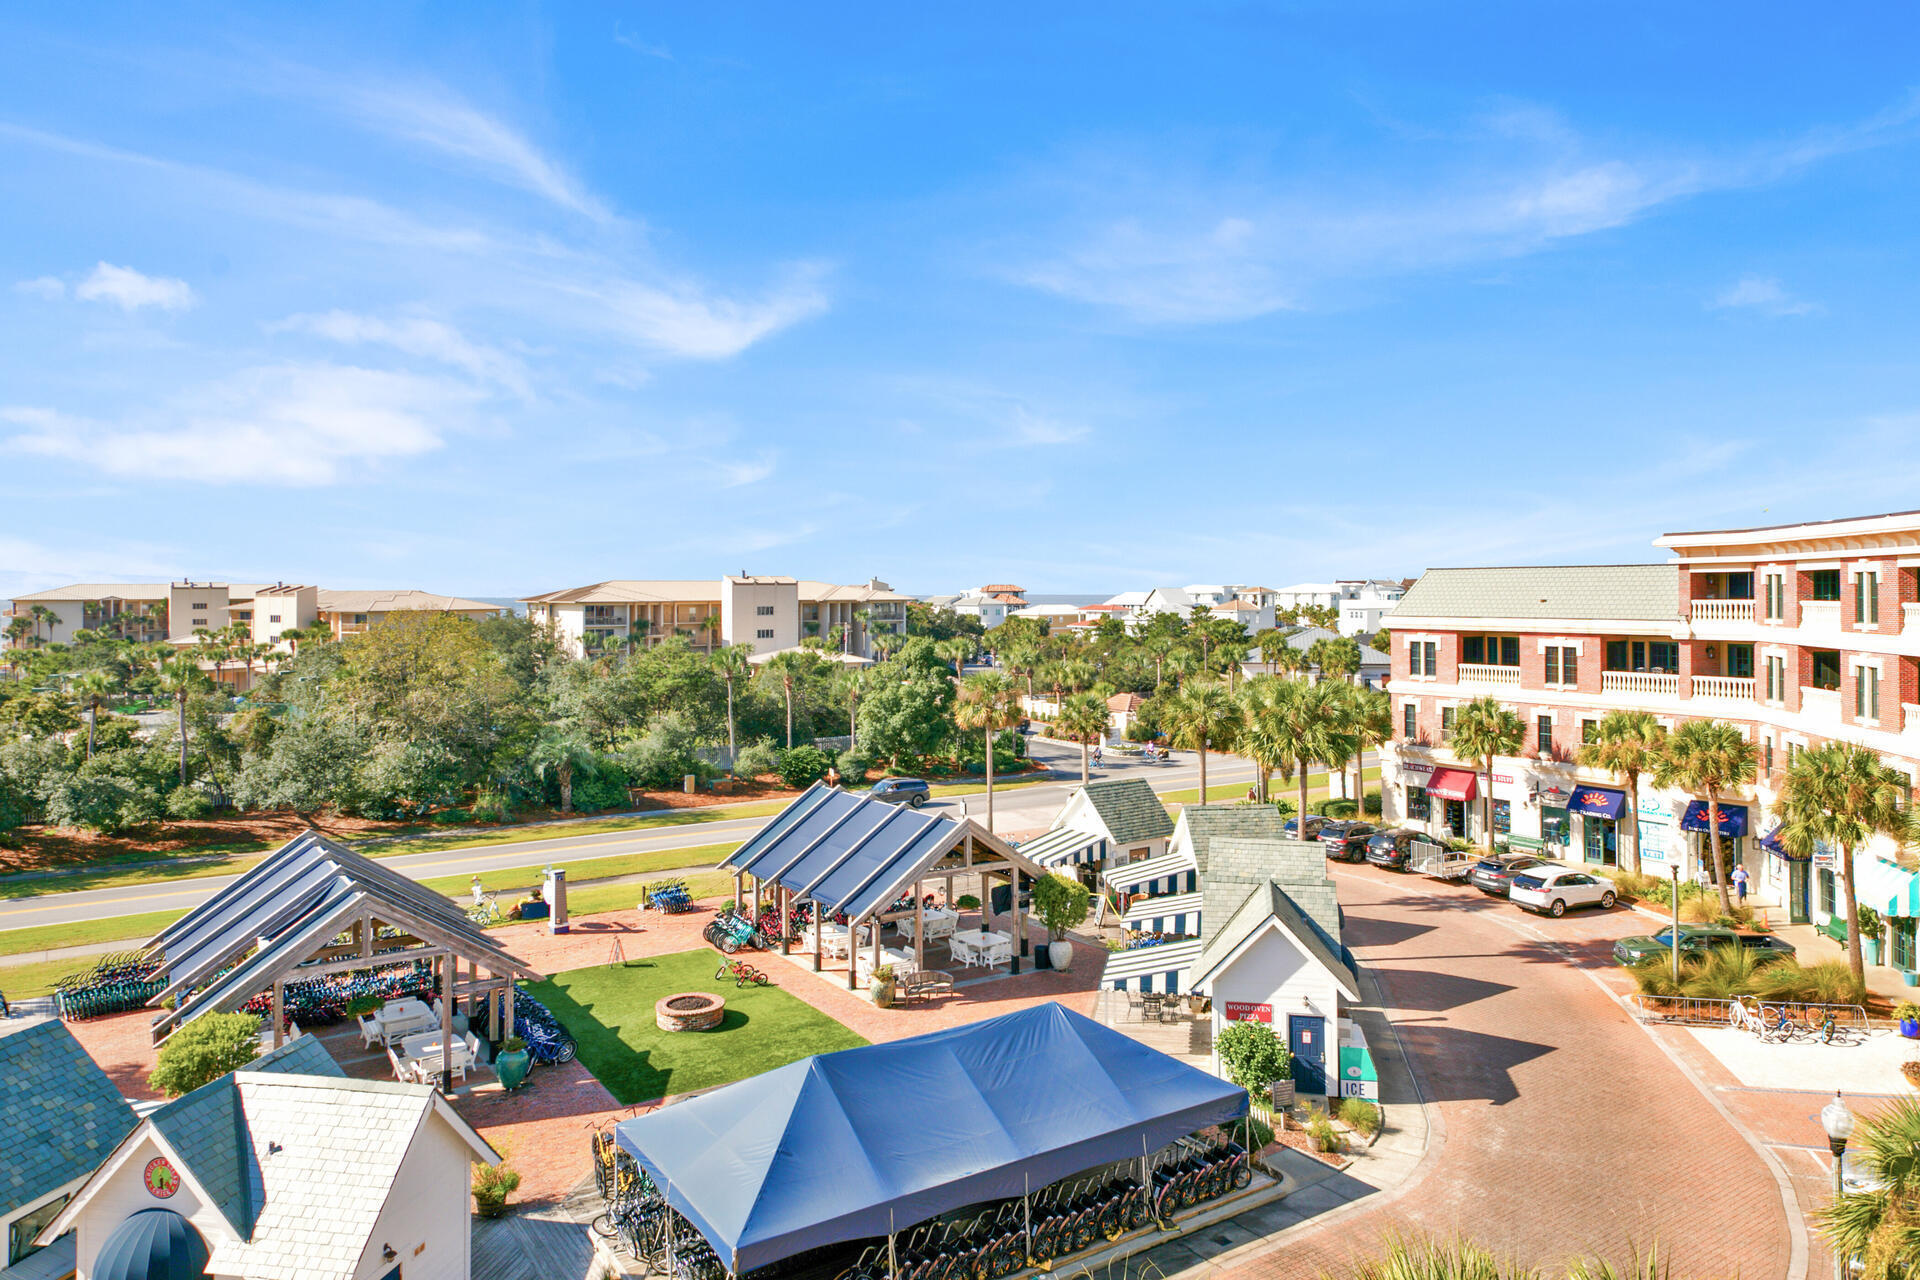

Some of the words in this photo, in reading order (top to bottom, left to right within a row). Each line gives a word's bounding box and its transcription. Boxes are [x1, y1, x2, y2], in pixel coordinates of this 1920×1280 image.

[1227, 1003, 1250, 1011] WOOD
[1250, 1005, 1271, 1013] OVEN
[1239, 1012, 1259, 1020] PIZZA
[1345, 1082, 1365, 1096] ICE
